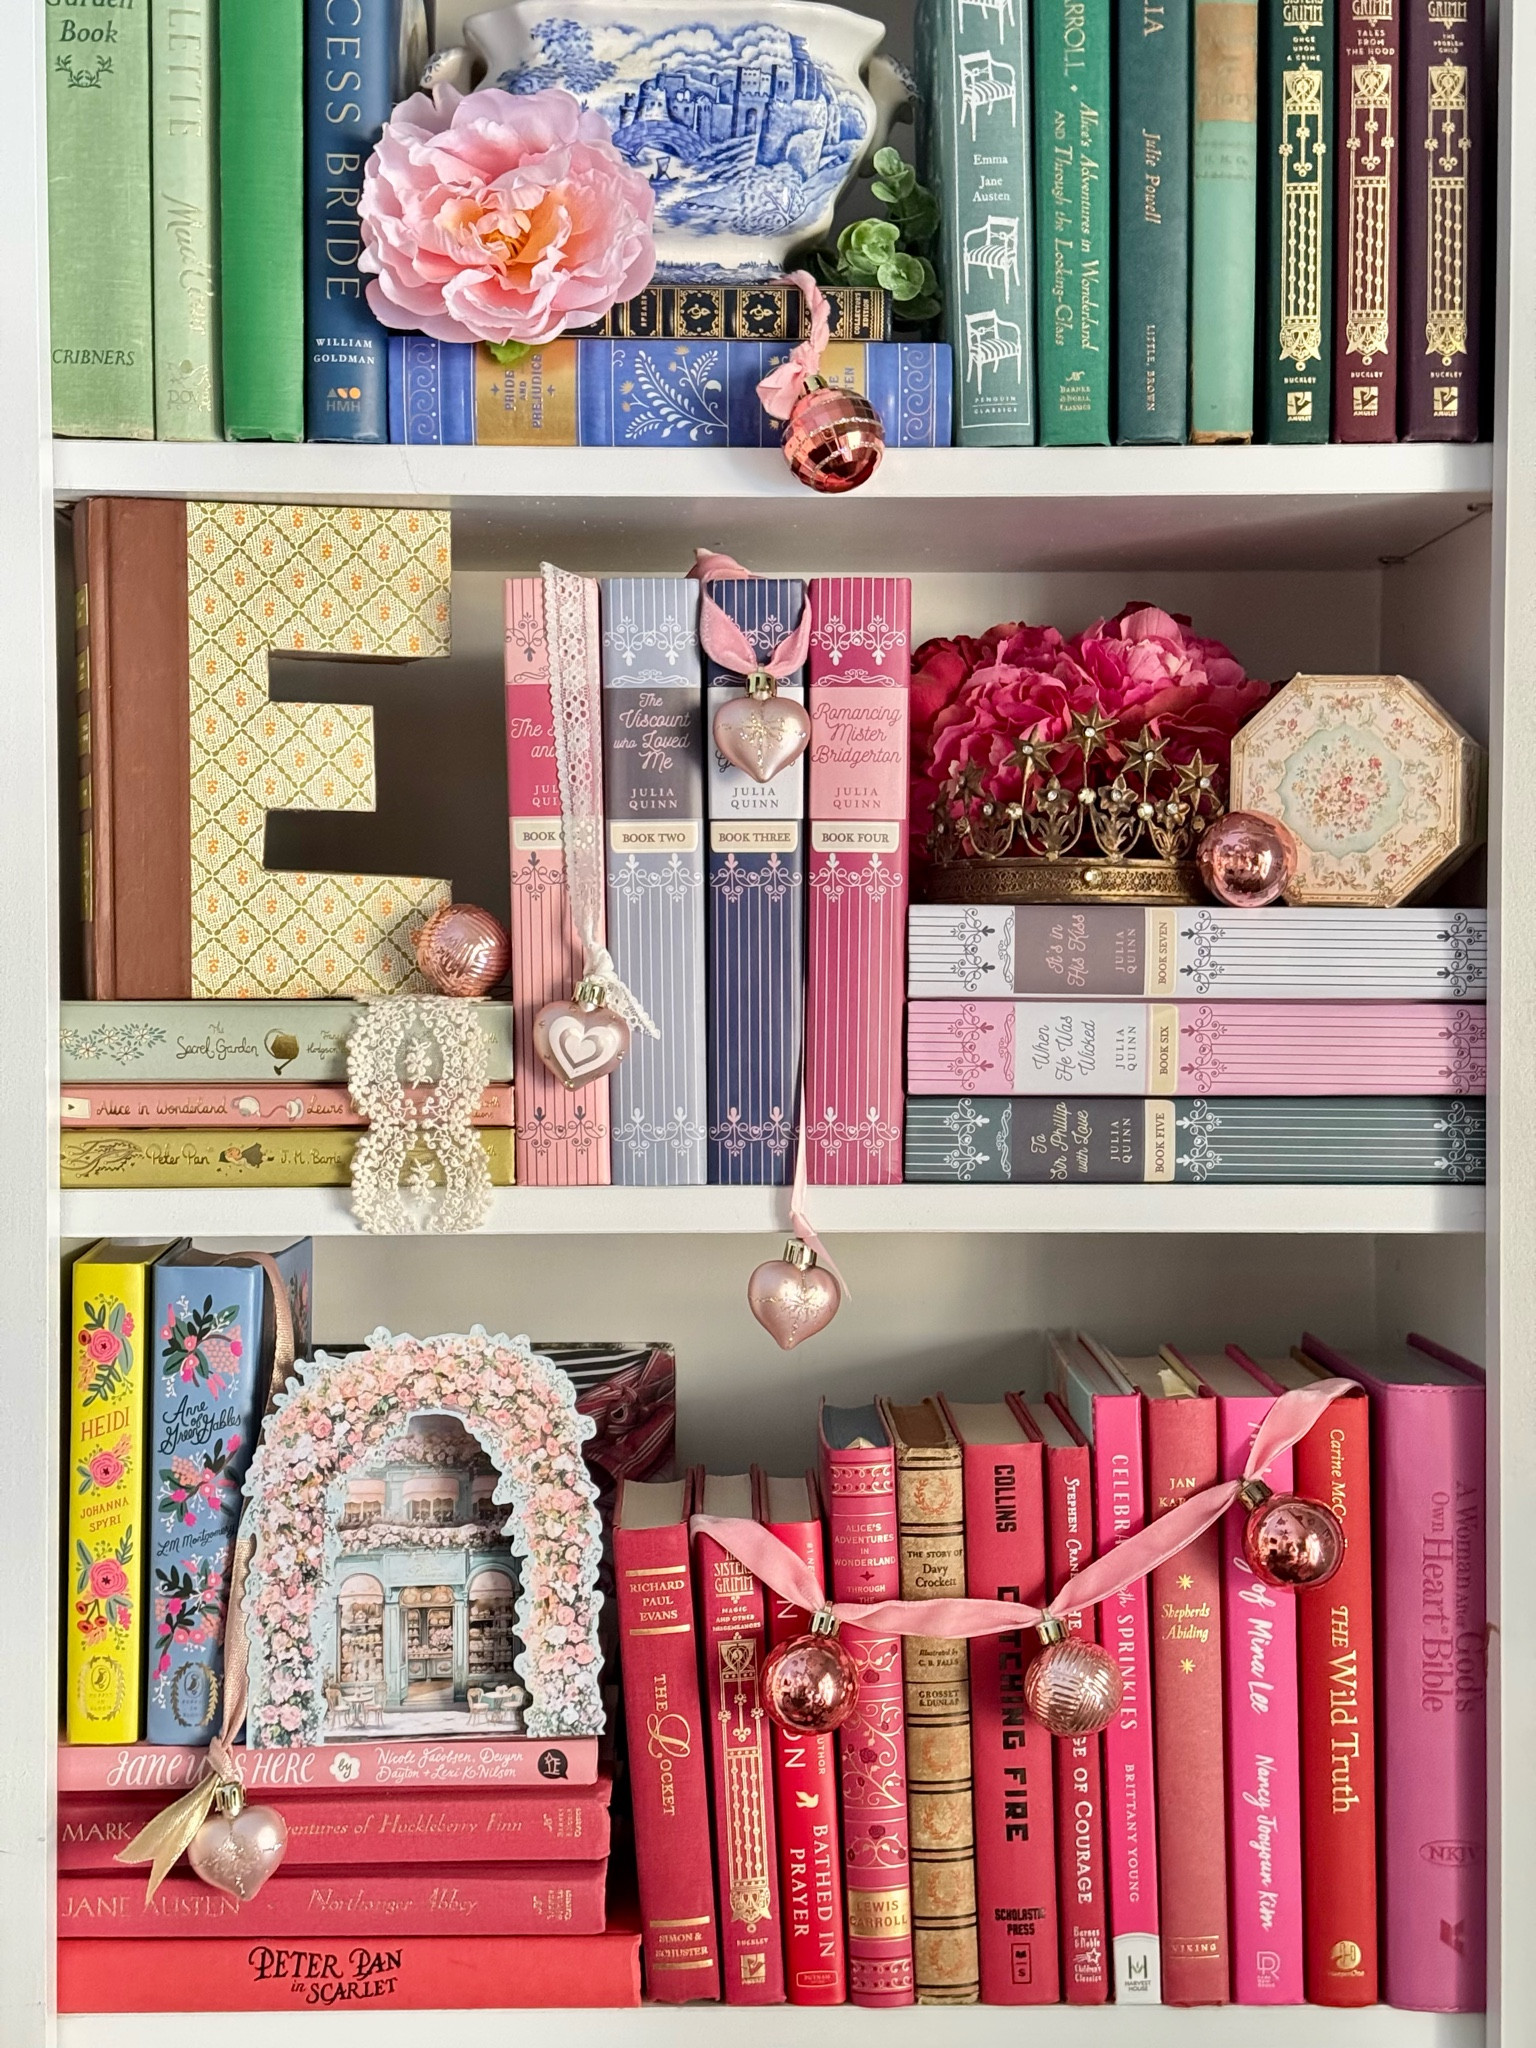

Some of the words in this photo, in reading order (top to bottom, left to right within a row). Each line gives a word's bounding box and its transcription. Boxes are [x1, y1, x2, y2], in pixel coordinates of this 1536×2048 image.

[1283, 5, 1323, 21] GRIMM
[1352, 0, 1392, 16] GRIMM
[1428, 1, 1467, 18] GRIMM
[59, 19, 118, 43] Book
[1055, 110, 1065, 140] AND
[1080, 102, 1099, 147] Alice's
[973, 154, 1008, 165] Emma
[1142, 128, 1162, 168] Julie
[979, 176, 1003, 189] Jane
[1052, 145, 1073, 205] Through
[973, 191, 1010, 202] Austen
[1080, 153, 1100, 234] Adventures
[1145, 173, 1162, 224] Powell
[326, 153, 360, 299] BRIDE
[1052, 238, 1073, 346] Looking-Glass
[1081, 260, 1099, 352] Wonderland
[315, 337, 372, 348] WILLIAM
[313, 354, 375, 366] GOLDMAN
[504, 370, 515, 411] PRIDE
[519, 381, 527, 401] AND
[531, 355, 542, 429] PREJUDICE
[974, 395, 1017, 403] PENGUIN
[1146, 370, 1156, 411] BROWN
[326, 400, 361, 413] HMH
[639, 693, 663, 707] The
[619, 710, 691, 728] Viscount
[813, 702, 902, 727] Romancing
[510, 718, 543, 739] The
[828, 722, 887, 743] Mister
[613, 739, 637, 749] who
[642, 733, 690, 751] Loved
[639, 751, 673, 770] Me
[811, 745, 902, 768] Bridgerton
[631, 788, 675, 798] JULIA
[731, 799, 779, 809] QUINN
[733, 787, 776, 796] JULIA
[833, 799, 881, 809] QUINN
[835, 787, 878, 797] JULIA
[629, 800, 678, 810] QUINN
[523, 832, 556, 841] BOOK
[622, 833, 655, 843] BOOK
[658, 832, 686, 842] TWO
[719, 832, 750, 842] BOOK
[754, 832, 791, 842] THREE
[822, 832, 854, 843] BOOK
[858, 832, 889, 843] FOUR
[1050, 924, 1064, 940] in
[1067, 914, 1089, 951] Kiss
[1159, 921, 1168, 954] SEVEN
[1045, 945, 1064, 974] It's
[1115, 931, 1125, 972] JULIA
[1127, 928, 1137, 974] QUINN
[1067, 957, 1088, 987] His
[1158, 956, 1167, 985] BOOK
[1055, 1015, 1073, 1052] Was
[1160, 1026, 1169, 1043] SIX
[176, 1036, 215, 1060] Secret
[216, 1037, 259, 1060] Garden
[1032, 1024, 1050, 1070] When
[1078, 1019, 1095, 1076] Wicked
[1115, 1028, 1125, 1069] JULIA
[1127, 1026, 1137, 1071] QUINN
[1055, 1056, 1076, 1081] He
[1160, 1046, 1168, 1075] BOOK
[97, 1099, 131, 1115] Alice
[156, 1097, 228, 1115] Wonderland
[1050, 1101, 1072, 1151] Phillip
[1071, 1109, 1093, 1144] Love
[1156, 1113, 1165, 1138] FIVE
[1031, 1133, 1047, 1154] To
[1111, 1121, 1120, 1161] JULIA
[1123, 1118, 1132, 1163] QUINN
[145, 1143, 180, 1166] Peter
[182, 1143, 210, 1166] Pan
[1074, 1147, 1088, 1173] with
[1155, 1141, 1164, 1173] BOOK
[1050, 1155, 1067, 1180] Sir
[162, 1395, 208, 1426] Anne
[80, 1406, 129, 1442] HEIDI
[1330, 1429, 1345, 1478] Carine
[1170, 1477, 1196, 1490] JAN
[80, 1497, 129, 1519] JOHANNA
[994, 1464, 1017, 1533] COLLINS
[1064, 1476, 1080, 1533] STEPHEN
[89, 1516, 121, 1533] SPYRI
[1431, 1491, 1450, 1533] Own
[834, 1534, 895, 1544] ADVENTURES
[846, 1523, 882, 1532] ALICE'S
[907, 1550, 923, 1558] THE
[926, 1549, 951, 1558] STORY
[1456, 1503, 1478, 1590] Woman
[834, 1556, 896, 1567] WONDERLAND
[922, 1564, 949, 1576] Davy
[629, 1579, 685, 1593] RICHARD
[714, 1575, 754, 1593] GRIMM
[847, 1584, 886, 1593] THROUGH
[915, 1577, 957, 1588] Crockett
[642, 1596, 674, 1606] PAUL
[1239, 1584, 1276, 1609] of
[640, 1610, 678, 1622] EVANS
[1161, 1603, 1210, 1623] Shepherds
[1162, 1623, 1209, 1643] Abiding
[1331, 1605, 1349, 1648] THE
[1248, 1617, 1273, 1679] Mina
[1422, 1636, 1454, 1713] Bible
[1455, 1631, 1485, 1713] God's
[654, 1673, 669, 1712] THE
[918, 1690, 959, 1699] GROSSET
[1248, 1680, 1275, 1715] Lee
[1329, 1649, 1358, 1726] Wild
[107, 1751, 182, 1786] Jane
[338, 1757, 353, 1778] by
[375, 1747, 415, 1765] Nicole
[479, 1748, 524, 1767] Devynn
[375, 1766, 420, 1784] Dayton
[1073, 1767, 1088, 1793] OF
[1242, 1754, 1275, 1810] Nancy
[1331, 1732, 1360, 1814] Truth
[1004, 1768, 1029, 1842] FIRE
[1124, 1764, 1137, 1842] BRITTANY
[62, 1821, 132, 1842] MARK
[354, 1815, 374, 1835] of
[379, 1813, 478, 1836] Huckleberry
[1074, 1801, 1093, 1904] COURAGE
[1249, 1815, 1279, 1887] Jooyoun
[813, 1824, 835, 1922] BATHED
[1128, 1845, 1140, 1903] YOUNG
[790, 1848, 810, 1937] PRAYER
[62, 1896, 131, 1917] JANE
[142, 1895, 240, 1917] AUSTEN
[856, 1901, 900, 1911] LEWIS
[995, 1907, 1046, 1921] SCHOLASTIC
[1257, 1891, 1279, 1930] Kim
[850, 1914, 908, 1928] CARROLL
[1007, 1923, 1035, 1936] PRESS
[658, 1933, 693, 1944] SIMON
[819, 1933, 836, 1957] IN
[1172, 1943, 1217, 1952] VIKING
[248, 1946, 344, 1982] PETER
[349, 1947, 403, 1981] PAN
[655, 1946, 709, 1958] SCHUSTER
[291, 1979, 306, 1993] in
[305, 1976, 398, 2006] SCARLET
